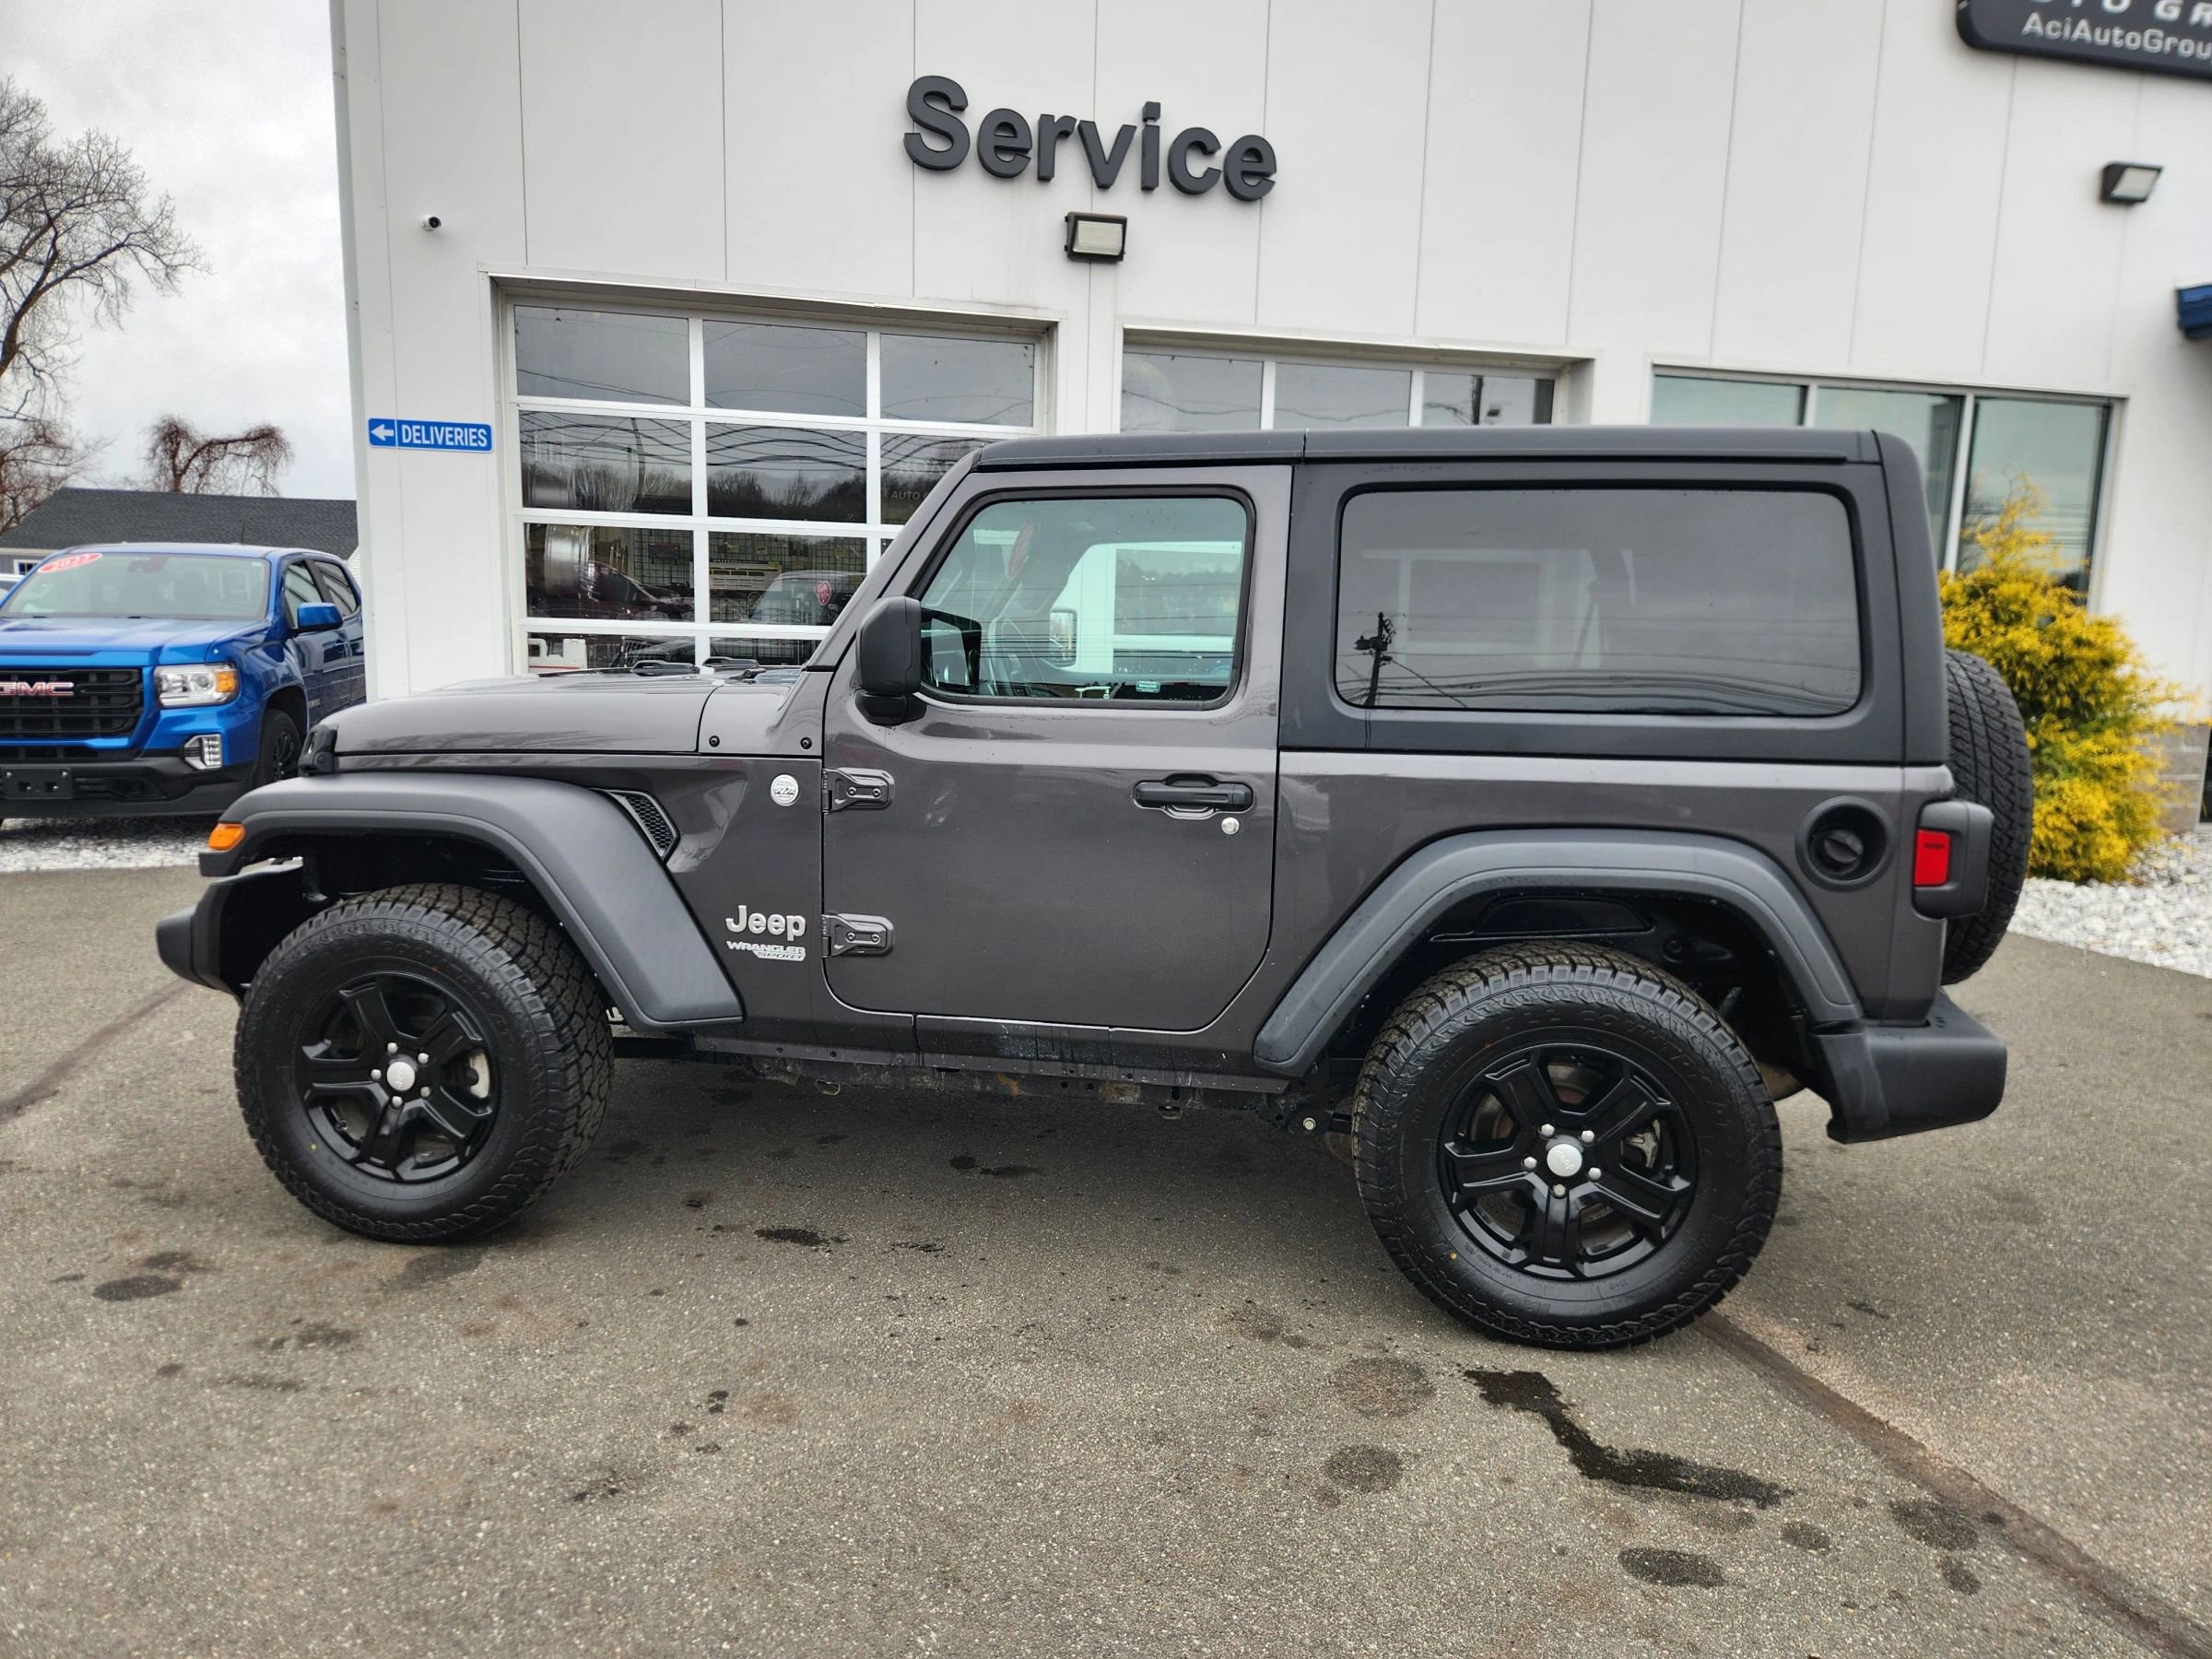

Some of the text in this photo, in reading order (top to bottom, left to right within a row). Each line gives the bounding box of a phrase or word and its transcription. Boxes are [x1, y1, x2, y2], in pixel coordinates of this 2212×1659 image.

[2021, 12, 2212, 63] AciAutoGrou
[903, 76, 1277, 201] Service
[401, 424, 488, 447] DELIVERIES
[724, 905, 806, 941] Jeep
[725, 940, 806, 955] WRANGLER
[756, 951, 804, 959] SPORT
